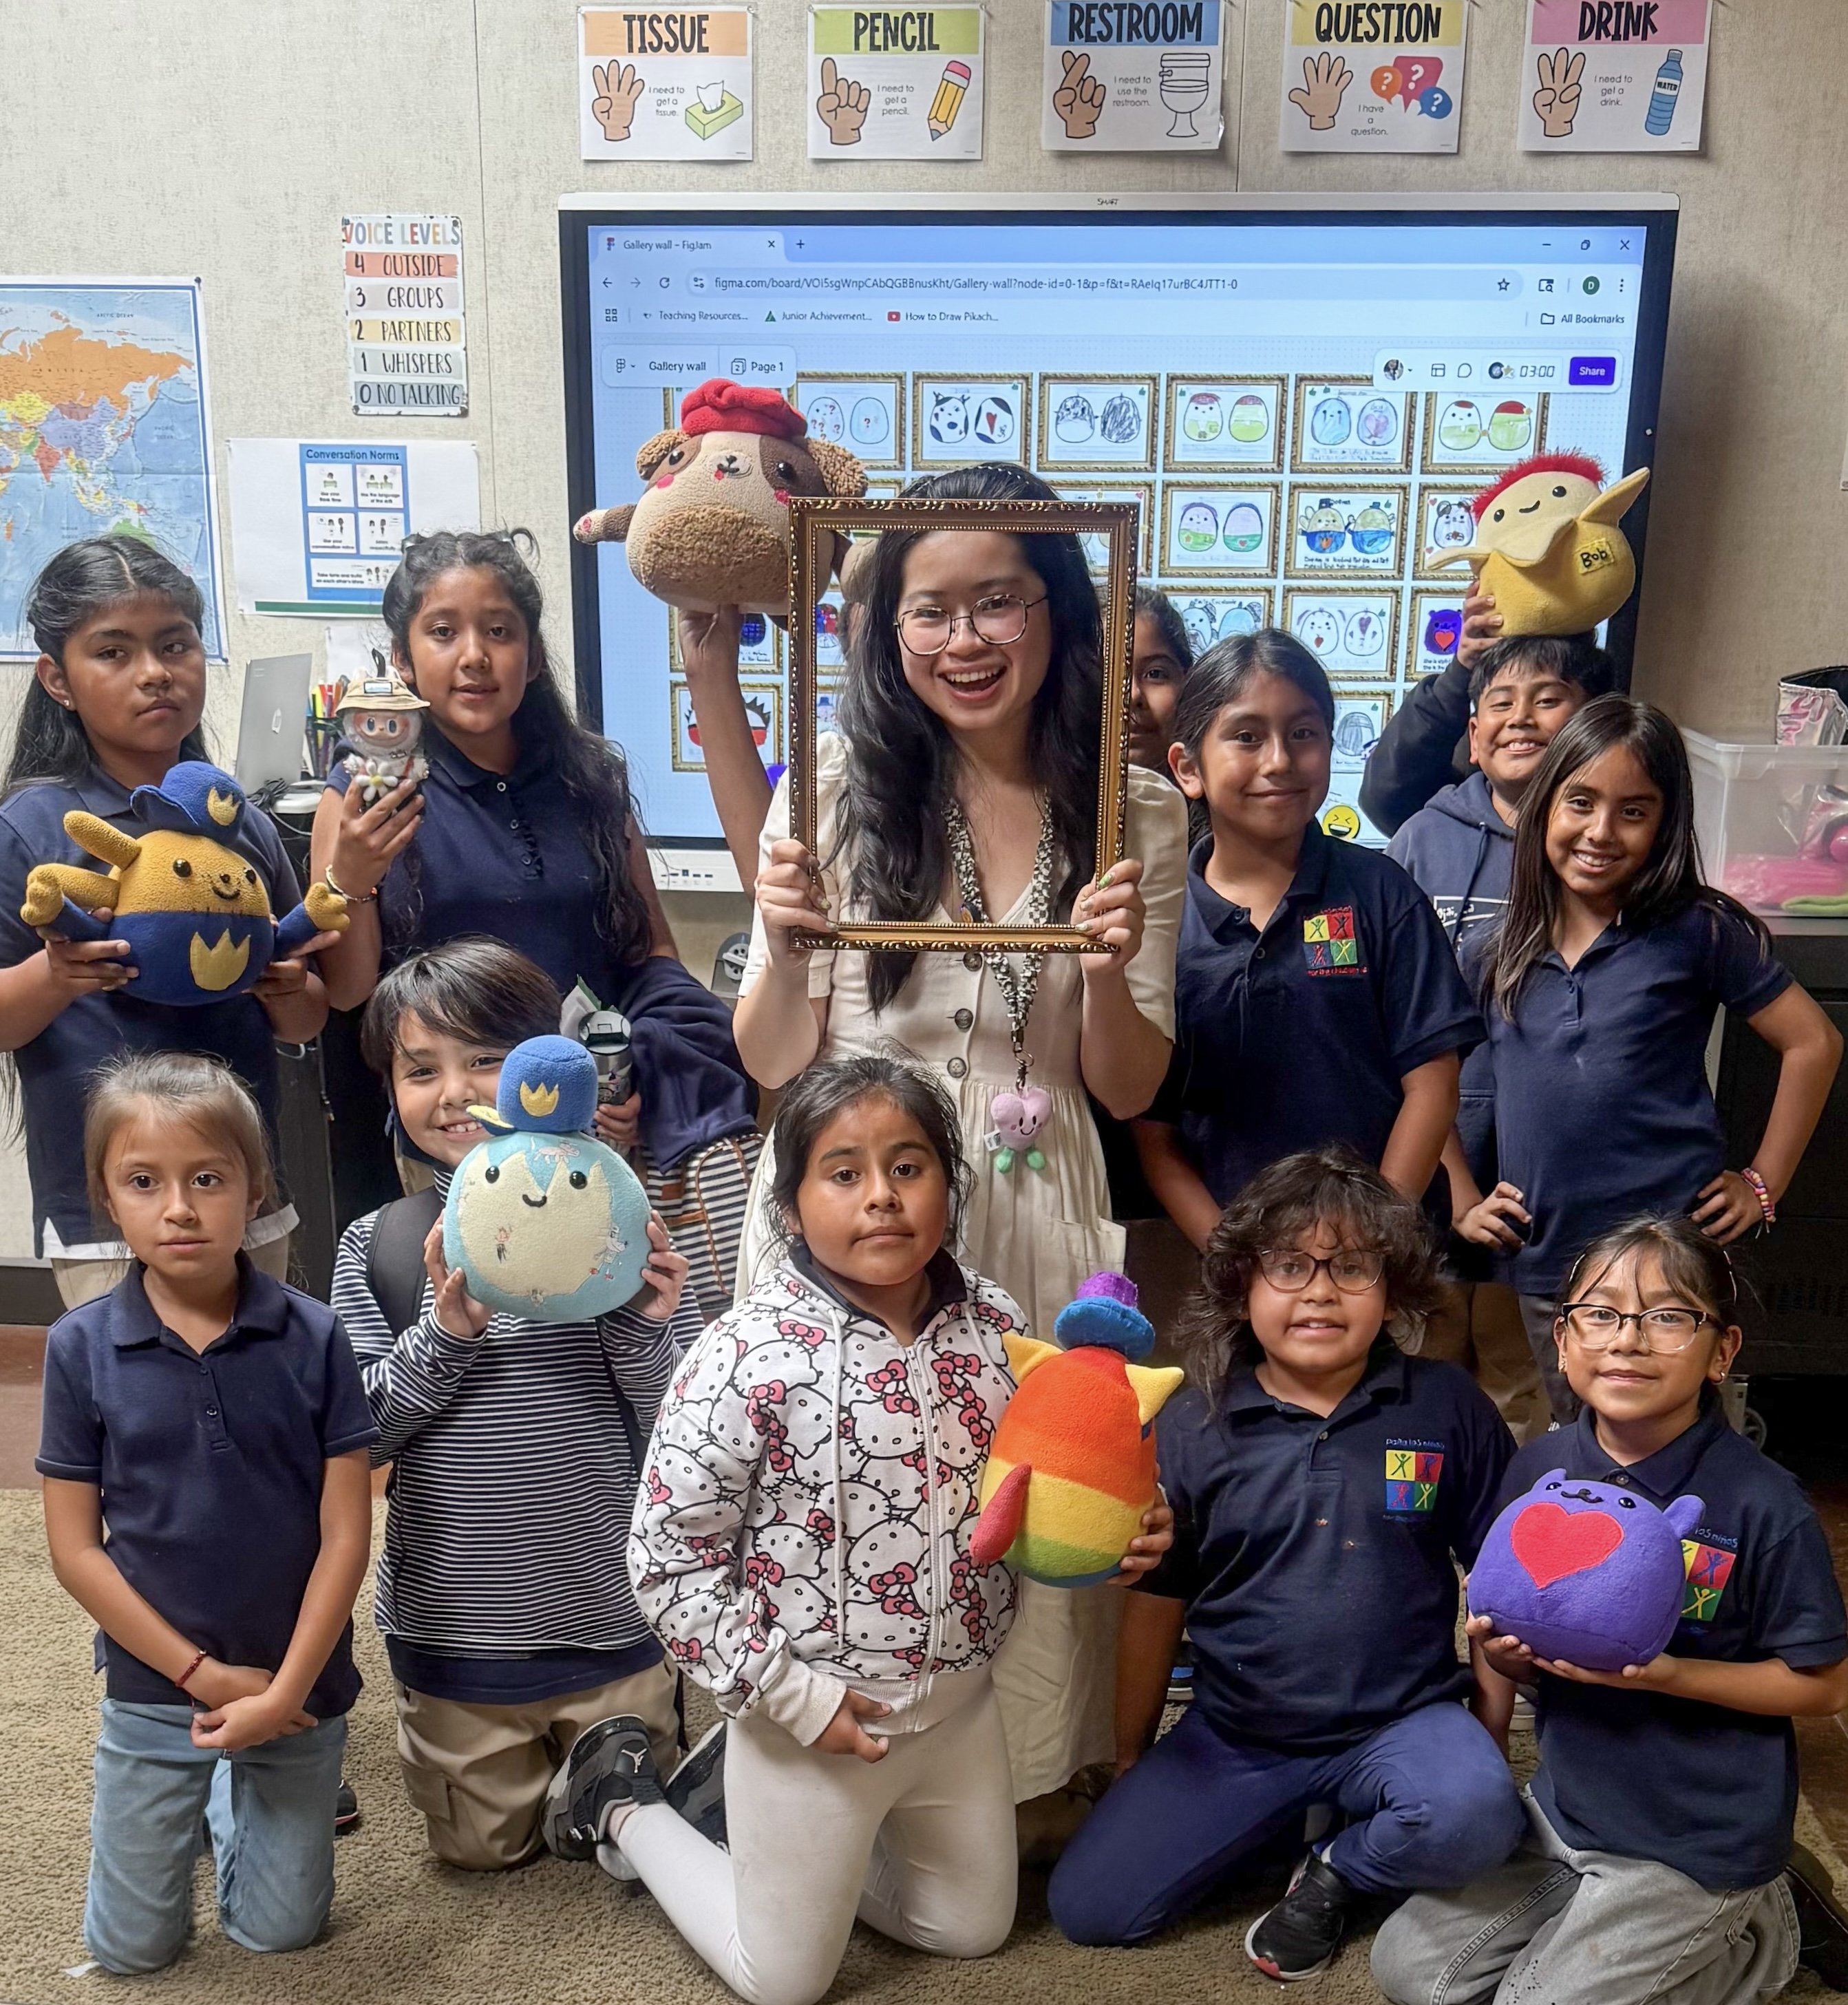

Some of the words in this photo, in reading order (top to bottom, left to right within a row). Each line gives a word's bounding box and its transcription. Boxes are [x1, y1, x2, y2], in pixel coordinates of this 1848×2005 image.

[1069, 3, 1203, 43] RESTROOM
[1315, 3, 1441, 43] QUESTION
[1578, 1, 1659, 41] DRINK
[623, 14, 710, 54] TISSUE
[854, 12, 939, 52] PENCIL
[1118, 75, 1140, 83] need
[1143, 75, 1151, 83] to
[1598, 74, 1622, 83] need
[1624, 74, 1633, 83] to
[652, 86, 675, 94] need
[677, 86, 685, 94] to
[882, 84, 904, 93] need
[1601, 86, 1615, 97] get
[1657, 81, 1678, 92] WATER
[656, 98, 670, 107] get
[884, 96, 899, 105] get
[1112, 98, 1151, 107] restroom.
[1363, 105, 1384, 113] have
[1350, 127, 1389, 136] question.
[342, 222, 394, 245] VOICE
[400, 222, 460, 245] LEVELS
[623, 240, 654, 252] Gallery
[655, 240, 672, 250] wall
[681, 240, 712, 252] FigJam
[354, 253, 365, 273] 4
[383, 253, 447, 277] OUTSIDE
[1588, 282, 1594, 290] D
[355, 286, 366, 308] 3
[387, 286, 444, 308] GROUPS
[659, 310, 696, 322] Teaching
[781, 312, 807, 321] Junior
[906, 311, 925, 321] How
[928, 312, 937, 321] to
[939, 312, 962, 321] Draw
[1561, 314, 1573, 323] All
[1575, 314, 1625, 323] Bookmarks
[354, 319, 365, 341] 2
[381, 320, 452, 342] PARTNERS
[361, 352, 368, 372] 1
[382, 352, 453, 374] WHISPERS
[649, 361, 683, 373] Gallery
[687, 361, 706, 372] wall
[751, 361, 776, 374] Page
[779, 361, 783, 372] 1
[1519, 365, 1555, 377] 03:00
[1579, 365, 1606, 376] Share
[360, 383, 372, 404] 0
[378, 384, 396, 405] NO
[400, 384, 460, 406] TALKING
[306, 449, 368, 459] Conversation
[370, 451, 399, 460] Norms
[1581, 548, 1607, 568] Bob
